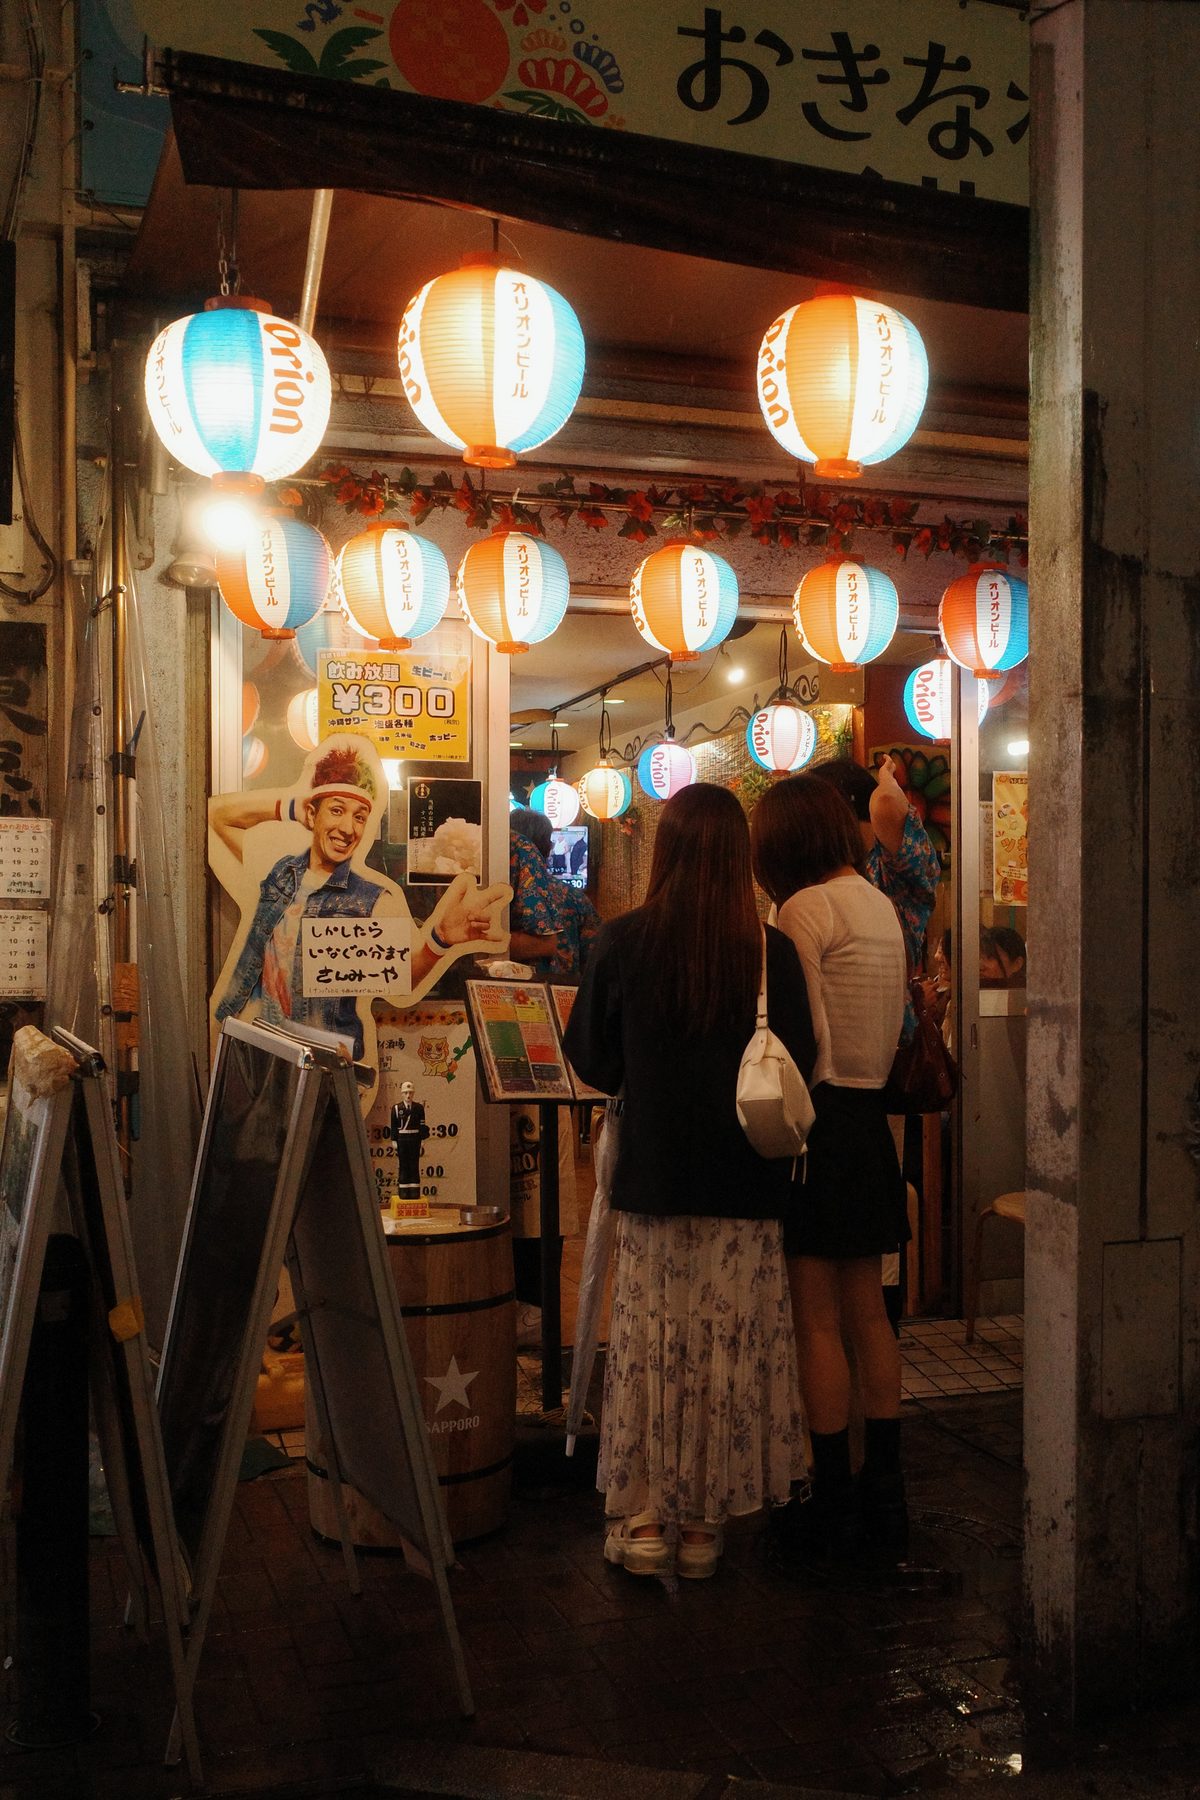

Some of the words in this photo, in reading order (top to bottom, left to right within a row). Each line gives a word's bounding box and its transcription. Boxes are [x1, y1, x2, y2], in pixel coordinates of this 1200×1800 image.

[512, 282, 531, 399] オリオンビール
[872, 313, 893, 424] オリオンビール
[261, 530, 278, 606] オリオンビール
[396, 540, 413, 611] オリオンビール
[517, 545, 529, 617] オリオンビール
[694, 558, 708, 627] オリオンビール
[847, 573, 858, 640] オリオンビール
[989, 582, 999, 648] オリオンビール
[327, 661, 400, 682] 飲み放題
[332, 683, 455, 718] ¥300
[309, 944, 410, 961] いなぐの分まで
